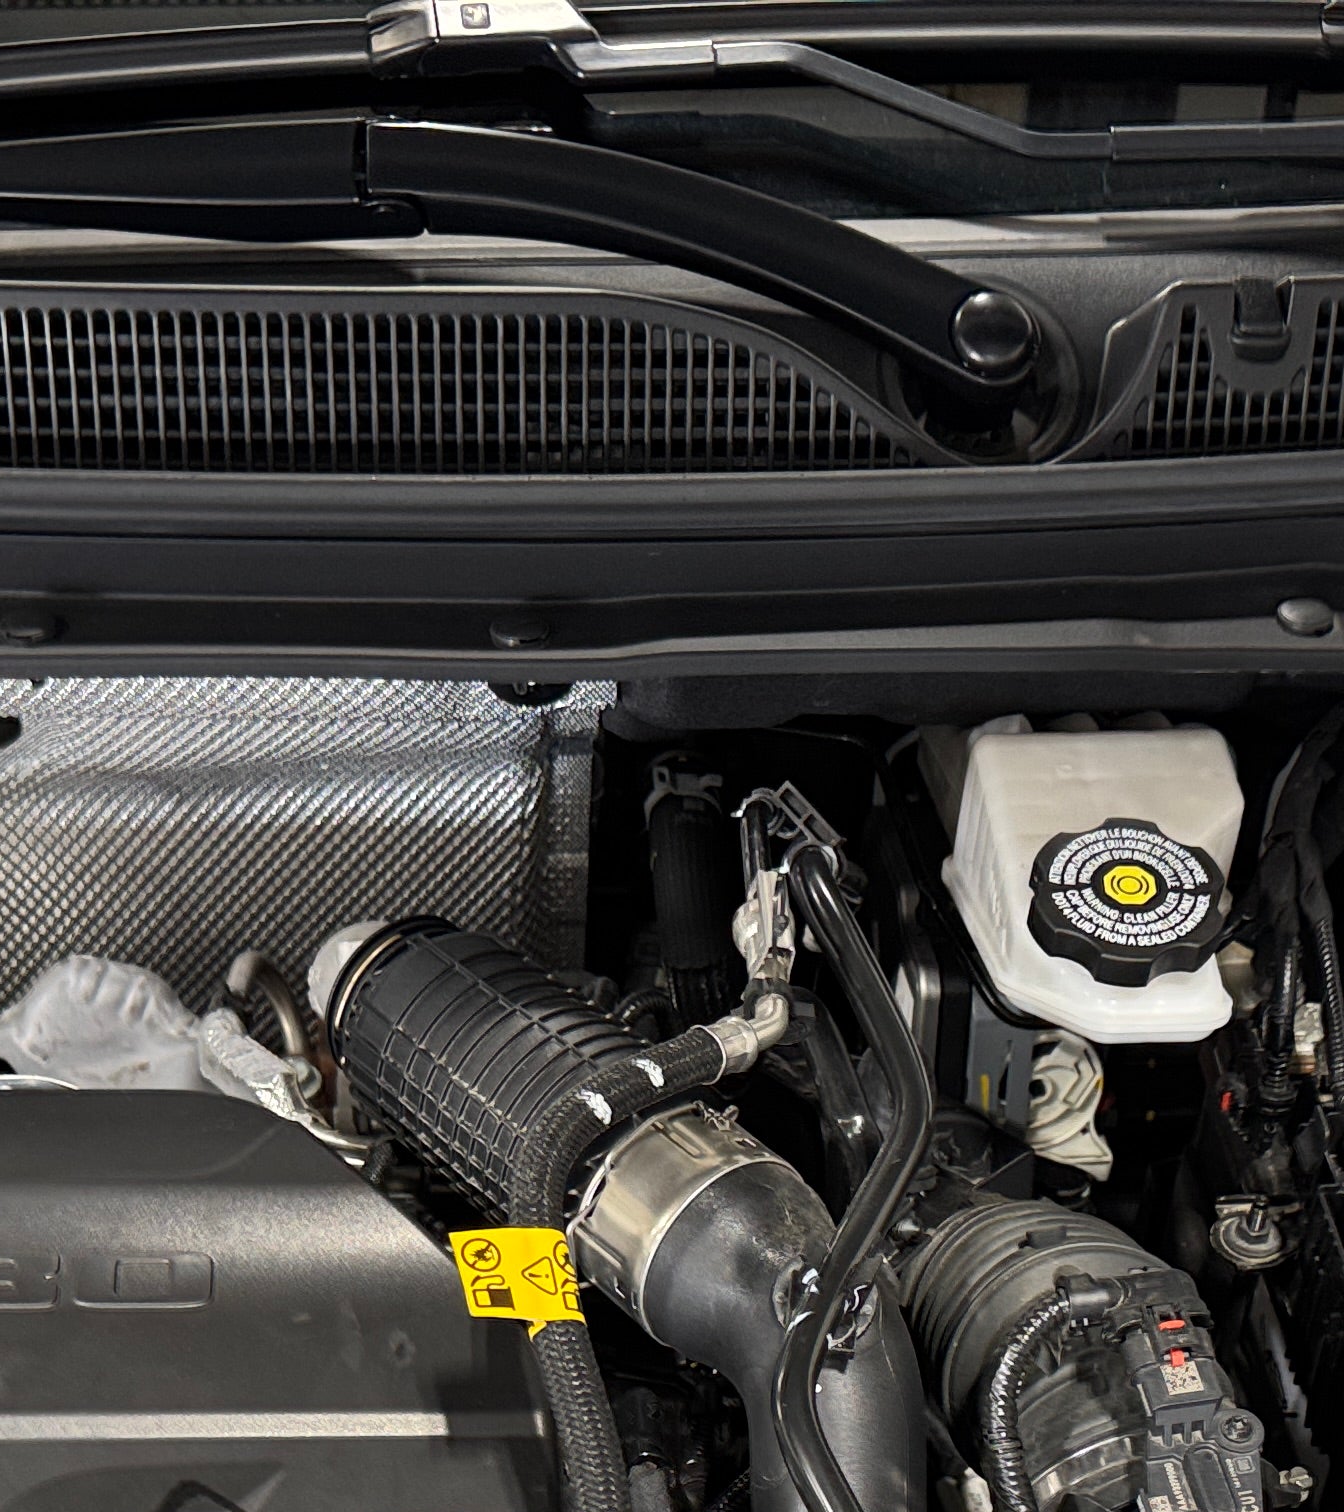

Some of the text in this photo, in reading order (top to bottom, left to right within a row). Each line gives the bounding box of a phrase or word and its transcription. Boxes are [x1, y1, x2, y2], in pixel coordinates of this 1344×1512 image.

[1107, 827, 1122, 839] LE
[1051, 891, 1072, 910] DOT
[1066, 911, 1097, 934] FLUID
[1093, 927, 1128, 945] FROM
[1136, 929, 1178, 947] SEALED
[1065, 889, 1085, 907] CAP
[1076, 904, 1116, 931] BEFORE
[1123, 910, 1160, 924] CLEAN
